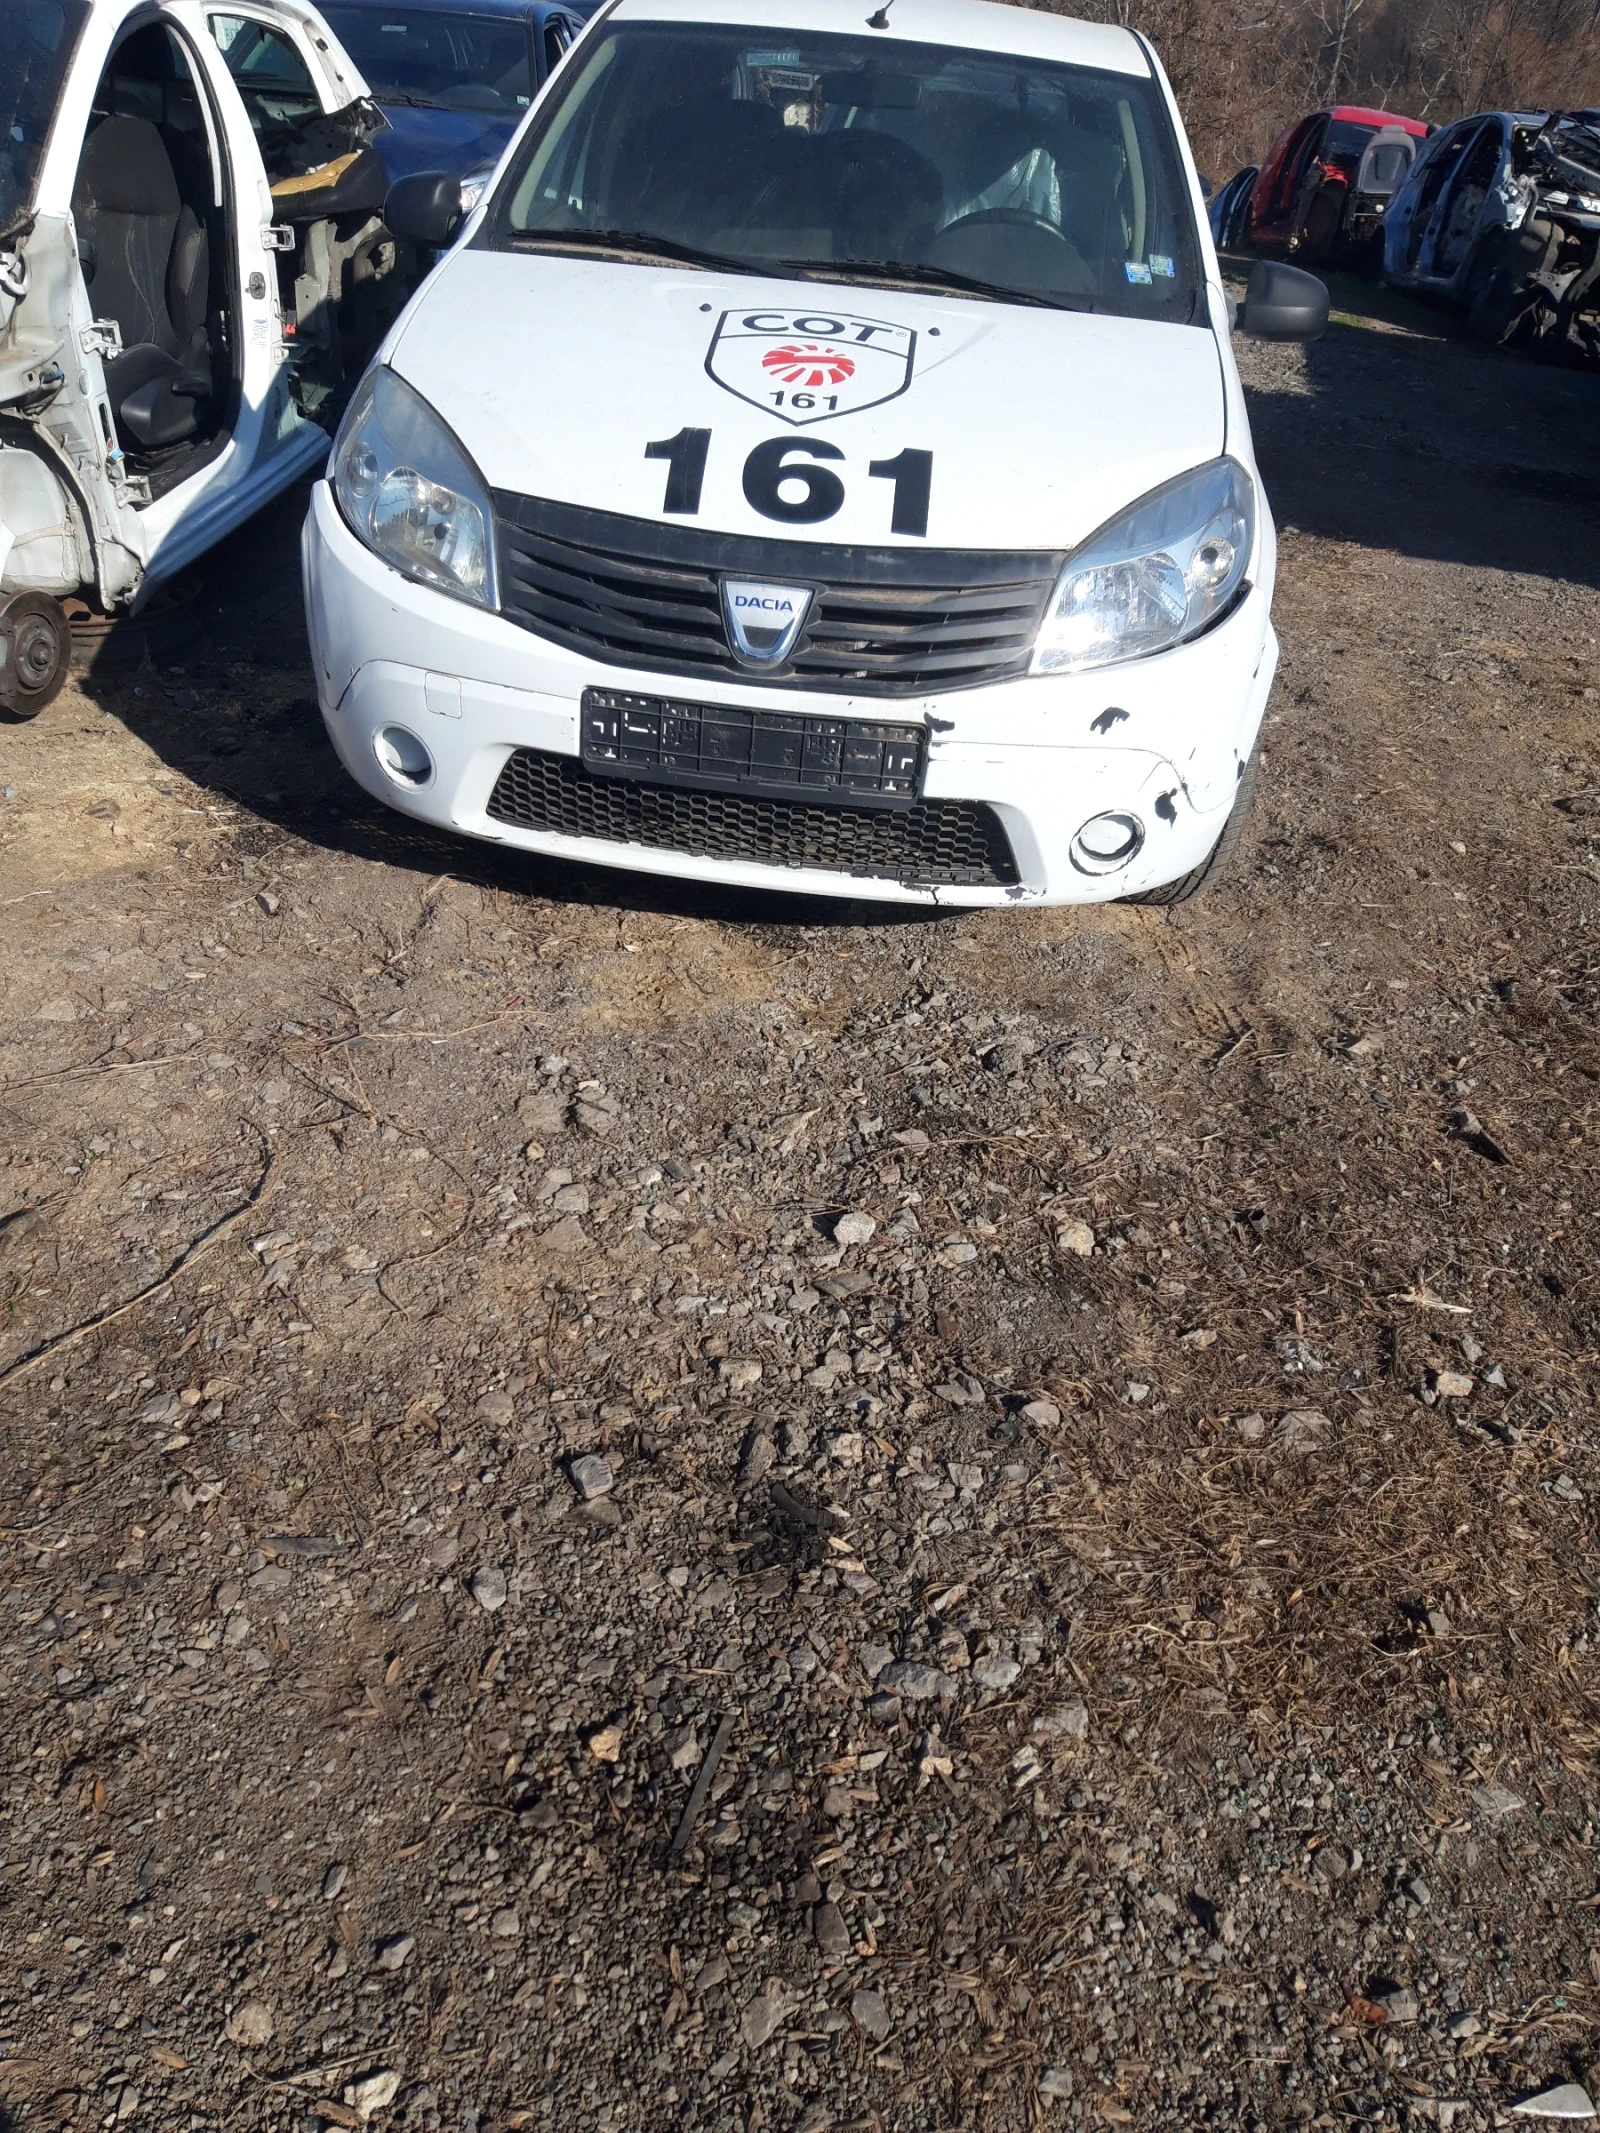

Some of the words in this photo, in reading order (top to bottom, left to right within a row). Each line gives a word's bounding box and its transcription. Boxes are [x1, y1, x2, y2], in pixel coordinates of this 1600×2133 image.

[769, 390, 839, 411] 161
[644, 426, 934, 539] 161
[735, 595, 793, 612] DACIA
